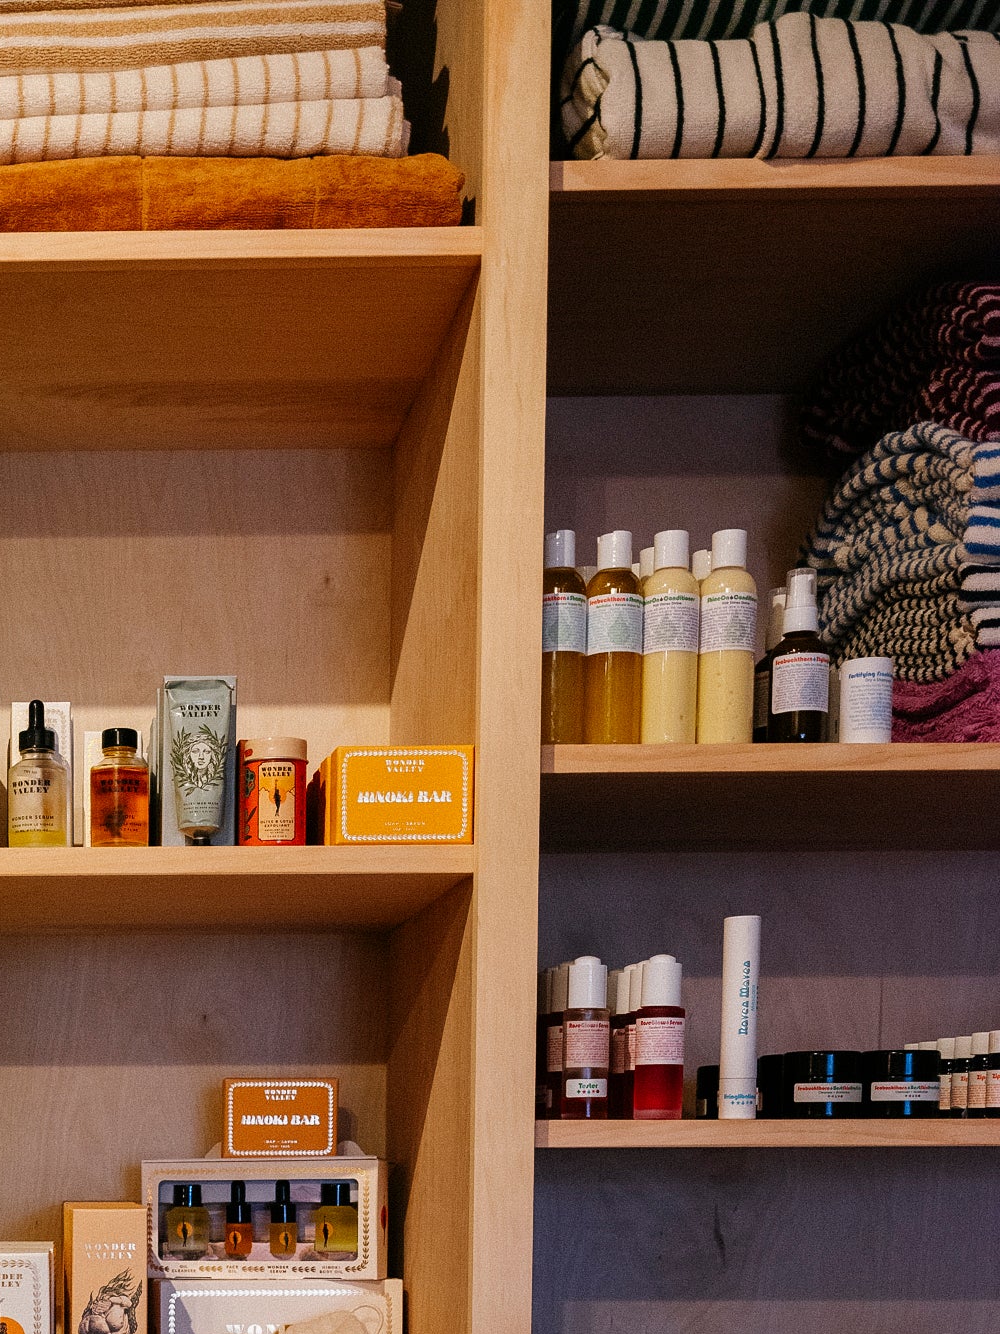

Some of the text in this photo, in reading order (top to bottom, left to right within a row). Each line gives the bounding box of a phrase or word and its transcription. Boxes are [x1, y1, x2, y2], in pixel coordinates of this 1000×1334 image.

[12, 779, 51, 788] WONDER
[14, 787, 49, 795] VALLEY
[357, 790, 452, 803] HINOKI BAR
[241, 1114, 320, 1126] HINOKI BAR
[84, 1242, 137, 1251] WONDER
[86, 1252, 133, 1260] VALLEY
